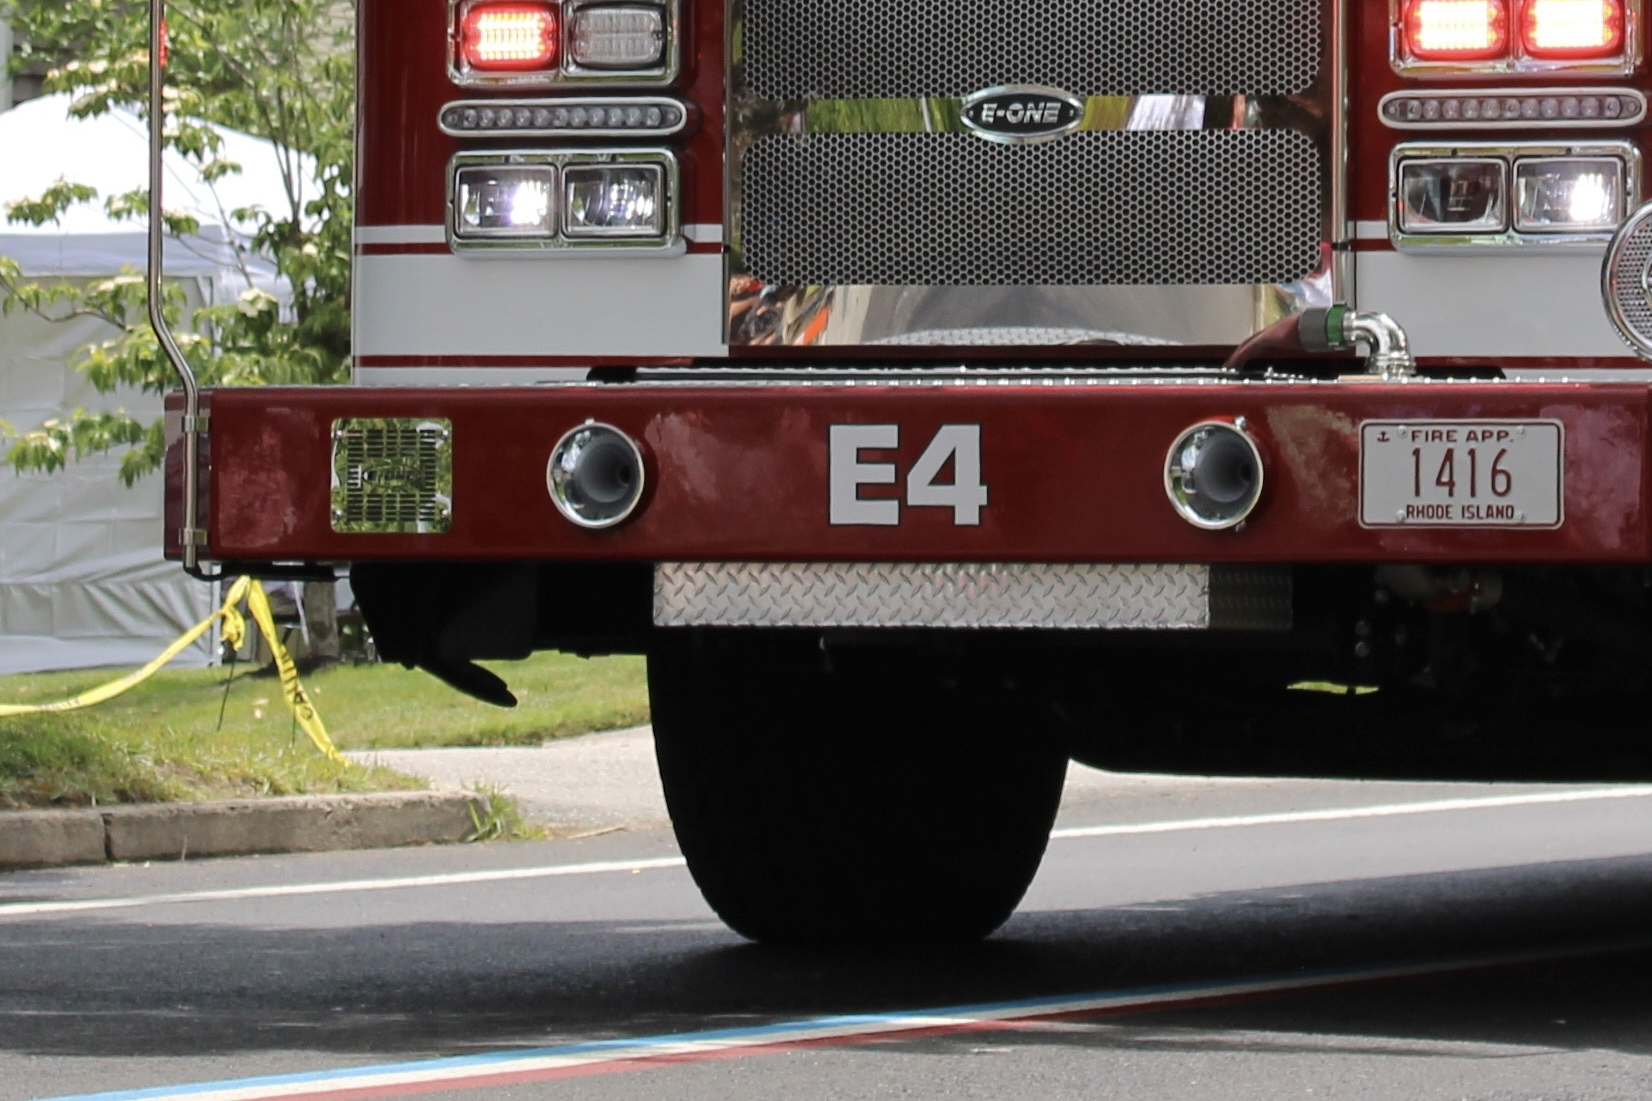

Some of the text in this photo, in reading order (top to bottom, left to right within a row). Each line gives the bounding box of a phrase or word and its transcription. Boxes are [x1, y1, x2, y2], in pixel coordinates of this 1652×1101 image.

[981, 102, 1061, 123] E-ONE
[1411, 430, 1514, 443] FIRE APP.
[829, 424, 988, 526] E4
[1412, 448, 1512, 498] 1416
[1406, 505, 1514, 519] RHODE ISLAND
